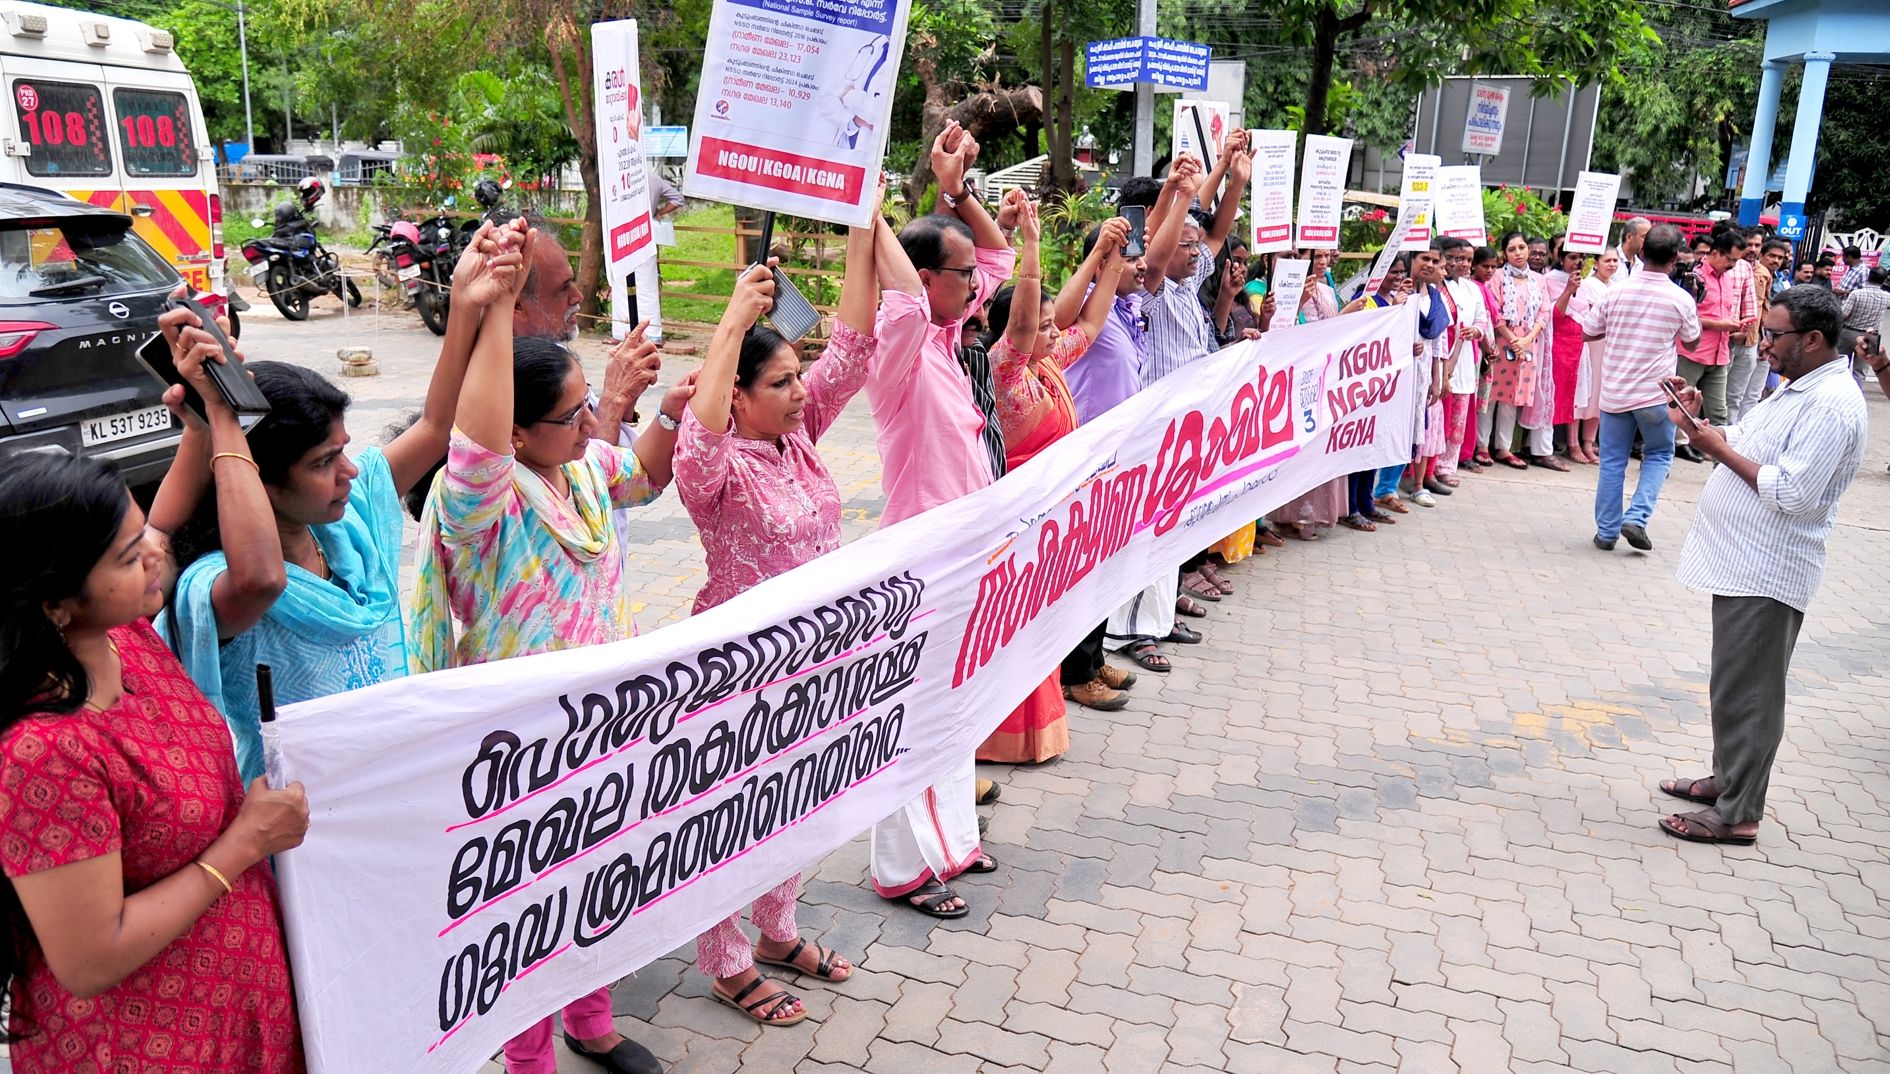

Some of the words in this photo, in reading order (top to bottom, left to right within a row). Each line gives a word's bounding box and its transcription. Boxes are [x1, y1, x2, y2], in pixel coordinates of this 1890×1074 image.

[734, 21, 750, 29] NSSO
[791, 5, 814, 18] Sample
[815, 10, 837, 24] Survey
[837, 16, 858, 28] report)
[778, 51, 801, 64] 23,123
[797, 42, 820, 55] 17,054
[725, 66, 741, 75] NSSO
[22, 97, 35, 107] 27
[770, 98, 792, 109] 13,140
[788, 88, 811, 101] 10,929
[22, 110, 87, 146] 108
[121, 115, 176, 147] 108
[1781, 227, 1802, 235] OUT
[1338, 337, 1392, 381] KGOA
[1327, 368, 1401, 425] NGOU
[90, 423, 107, 441] KL
[111, 416, 134, 436] 53T
[138, 408, 169, 430] 9235
[1304, 408, 1316, 433] 3
[1325, 415, 1376, 454] KGNA
[447, 761, 635, 920] മേഖല
